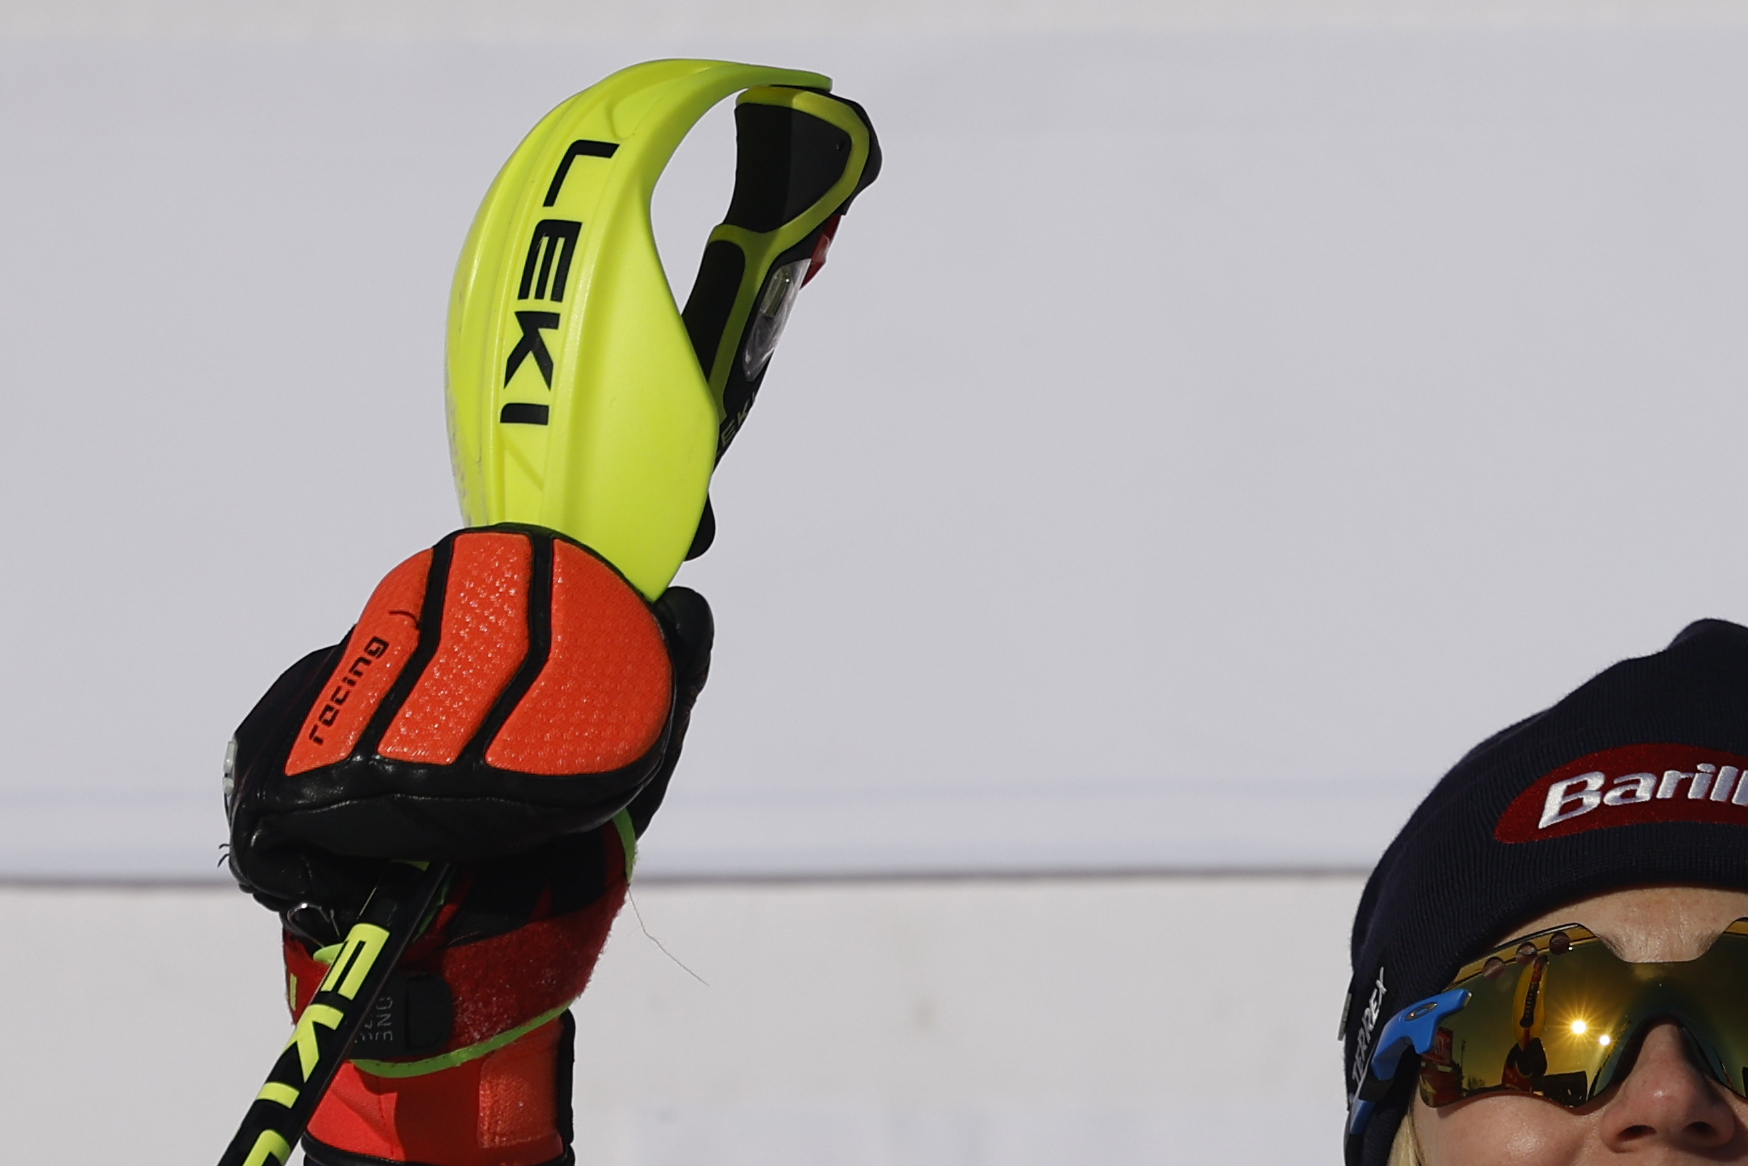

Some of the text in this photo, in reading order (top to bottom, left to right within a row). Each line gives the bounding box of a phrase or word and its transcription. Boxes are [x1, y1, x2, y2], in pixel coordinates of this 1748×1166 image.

[500, 139, 620, 426] LEKI
[308, 635, 391, 746] racing
[258, 922, 391, 1108] EKI
[1352, 966, 1388, 1084] TERREX
